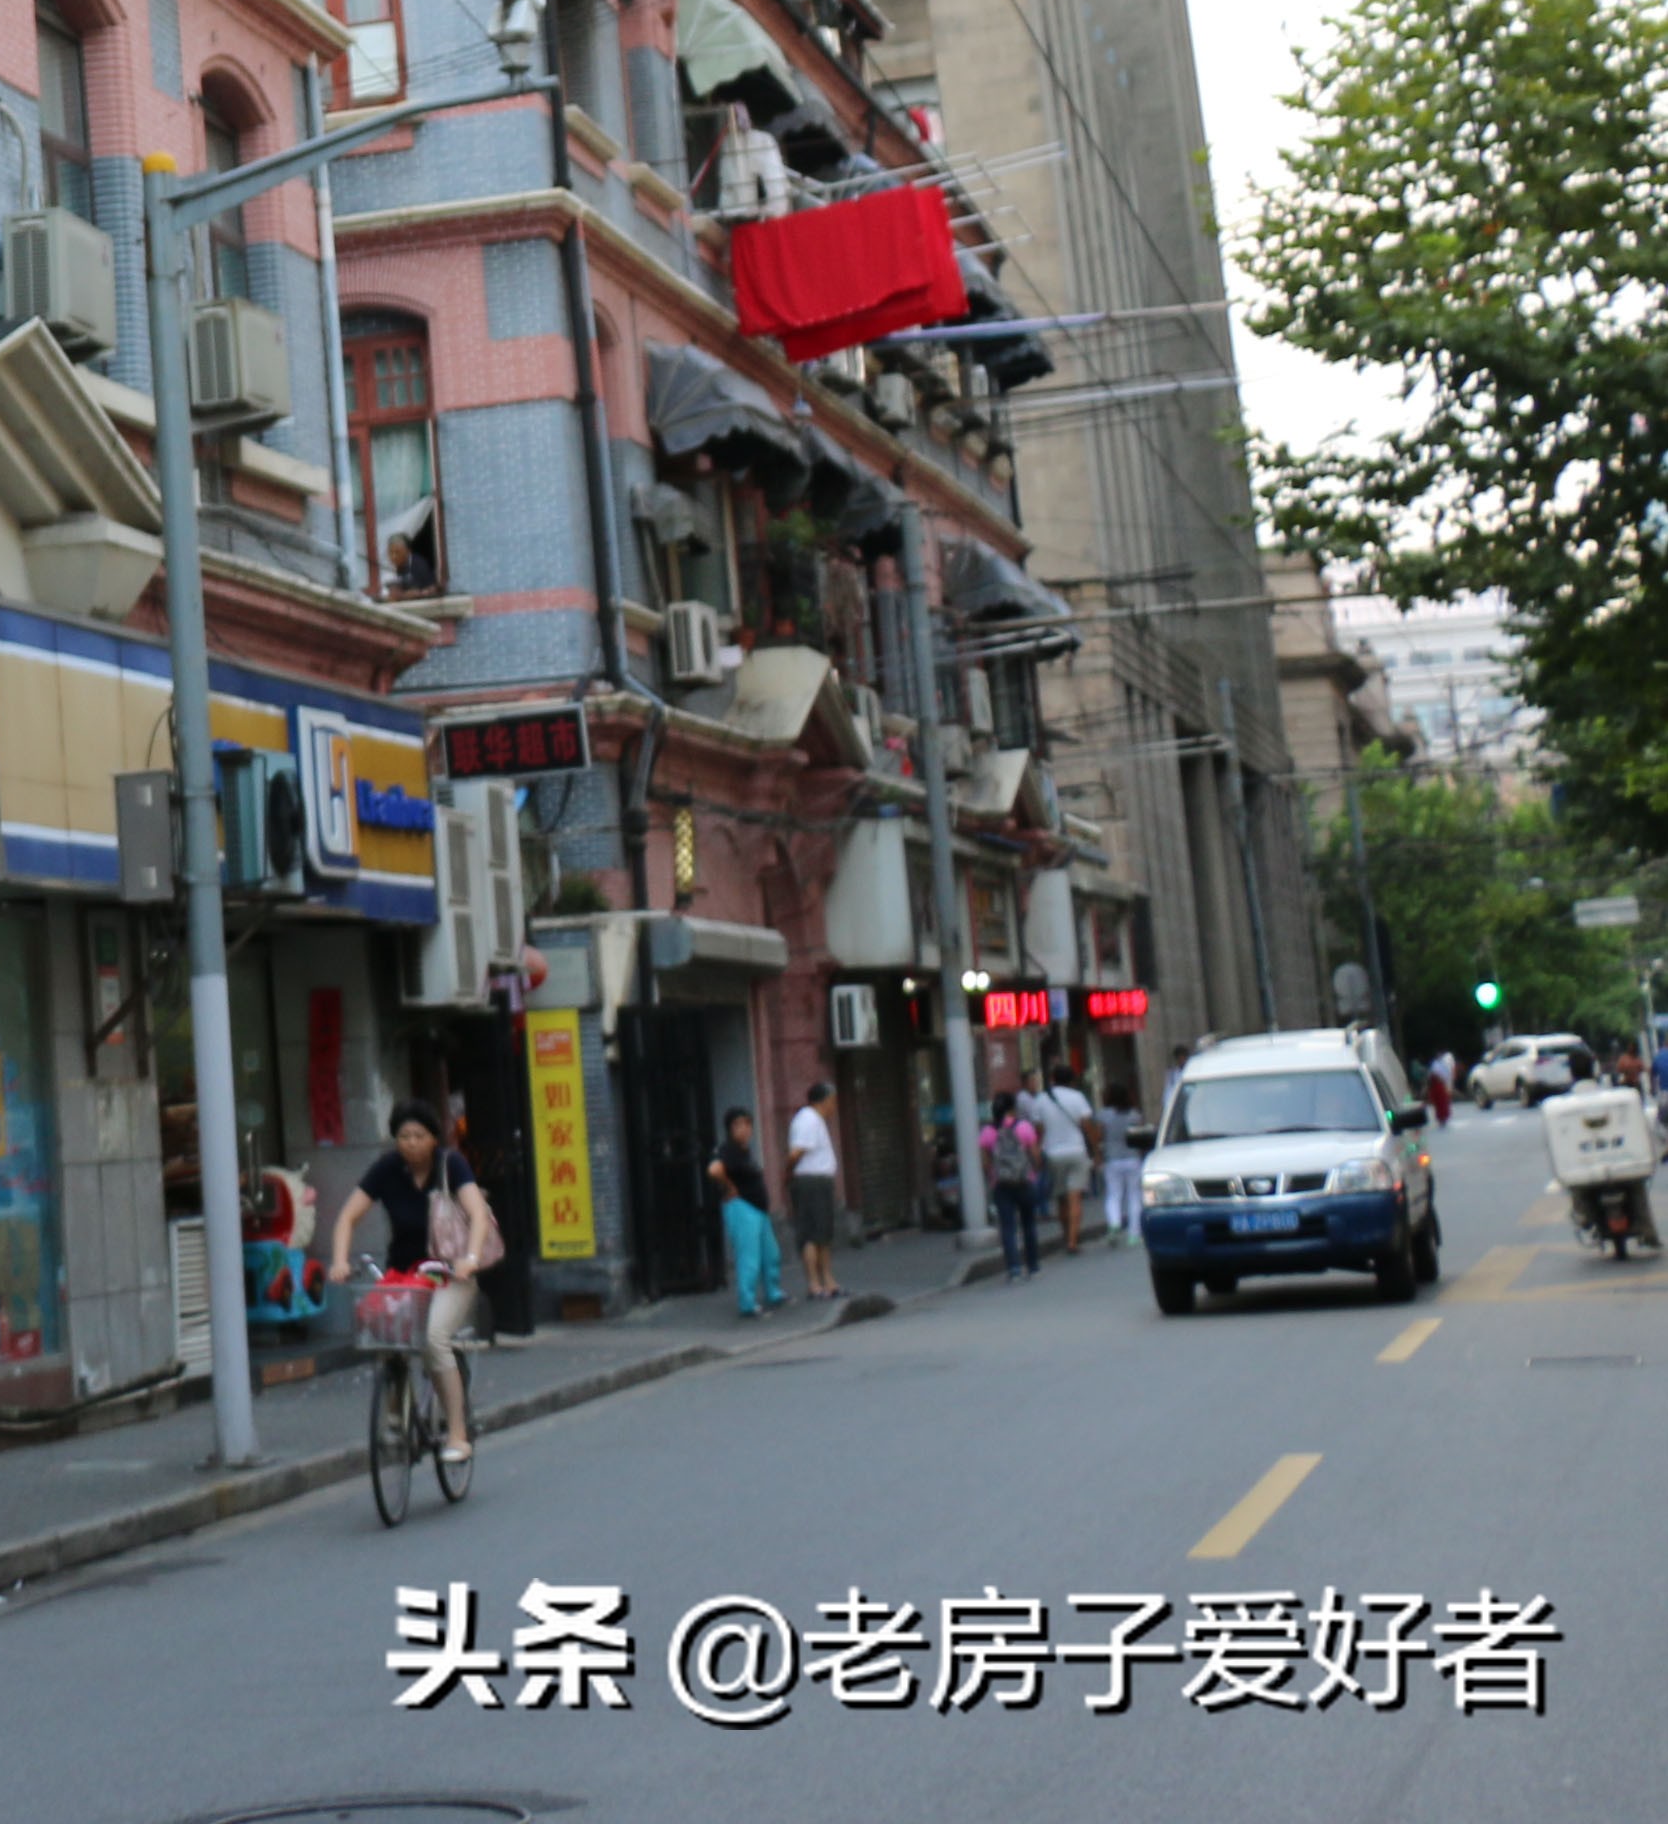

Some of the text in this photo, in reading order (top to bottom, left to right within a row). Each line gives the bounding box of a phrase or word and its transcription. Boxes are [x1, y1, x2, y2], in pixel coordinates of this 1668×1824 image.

[450, 718, 578, 773] 联华超市
[985, 990, 1048, 1030] 四川
[545, 1081, 581, 1225] 如家酒店
